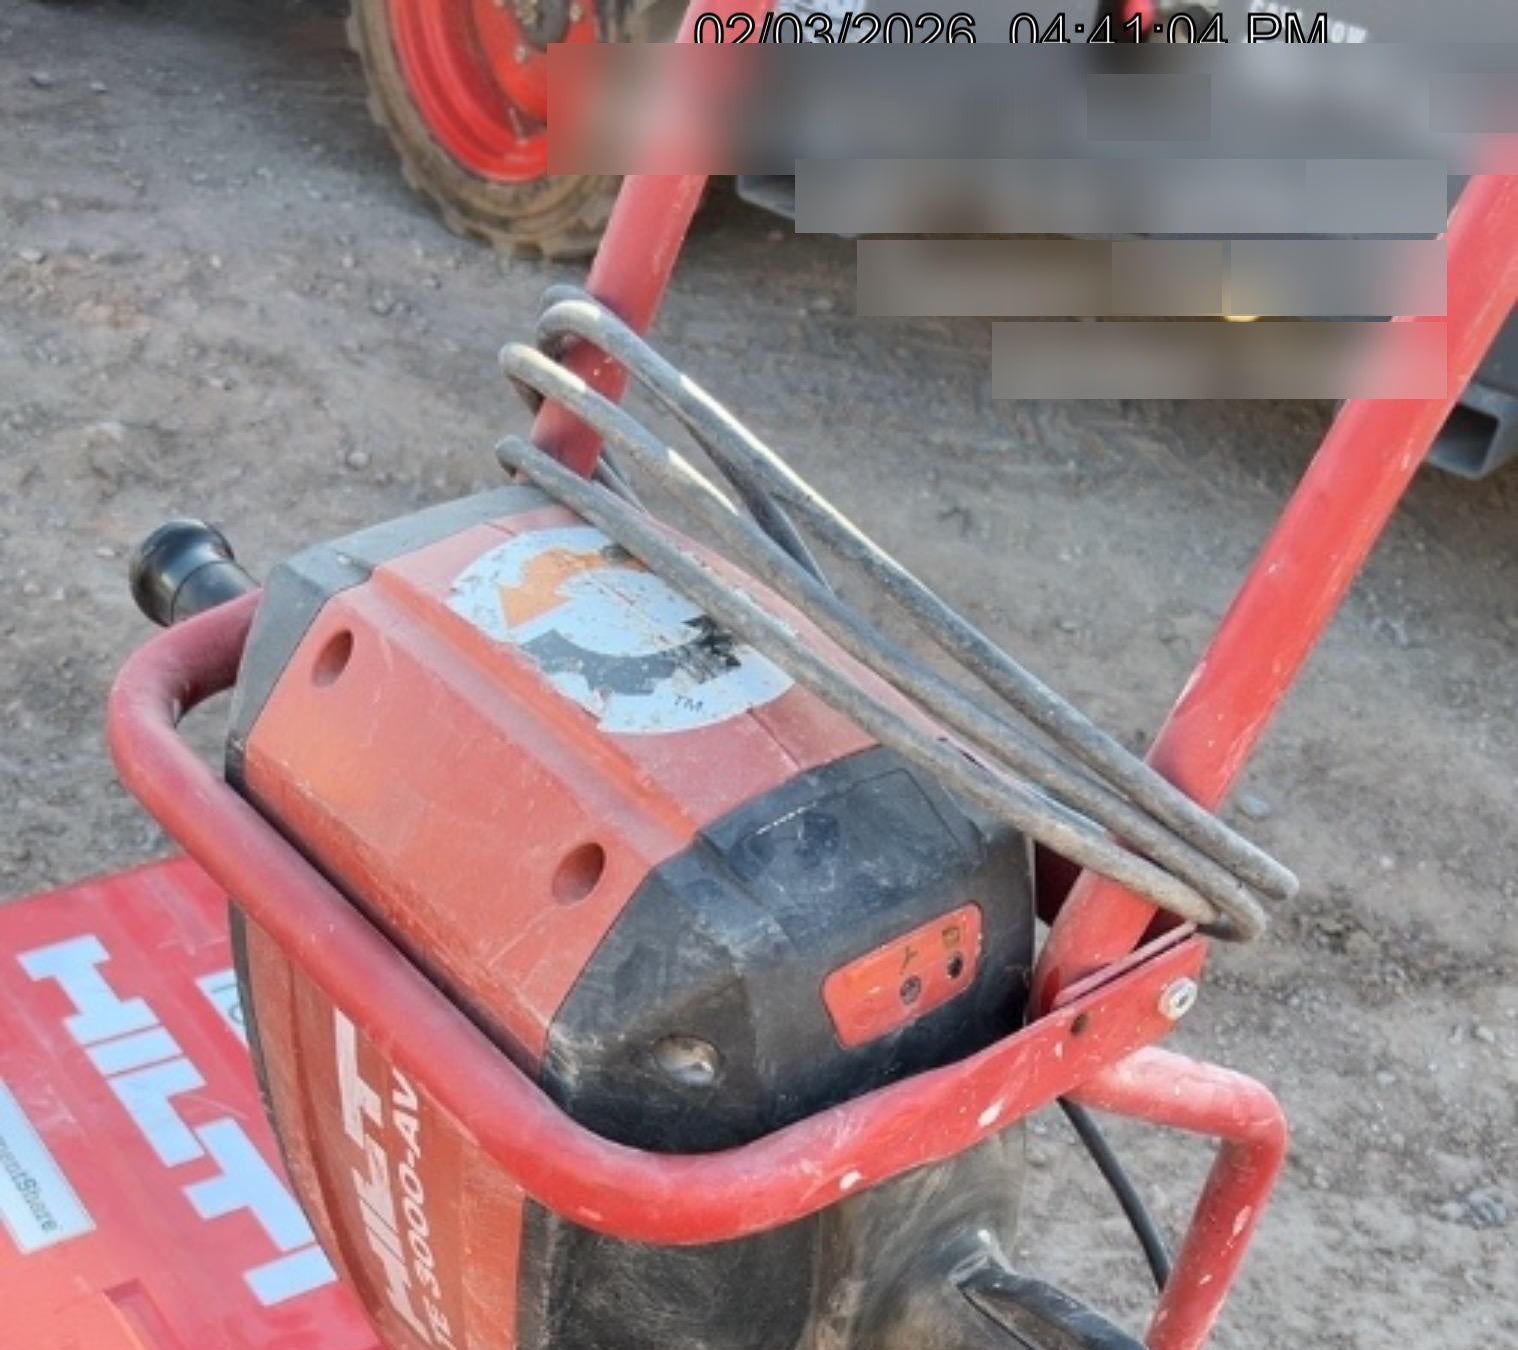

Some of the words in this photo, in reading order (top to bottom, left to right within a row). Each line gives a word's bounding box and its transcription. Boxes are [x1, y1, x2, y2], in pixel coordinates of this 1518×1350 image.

[17, 934, 337, 1306] HILTI
[334, 1006, 434, 1345] HILT
[392, 1066, 442, 1300] 3000-AV
